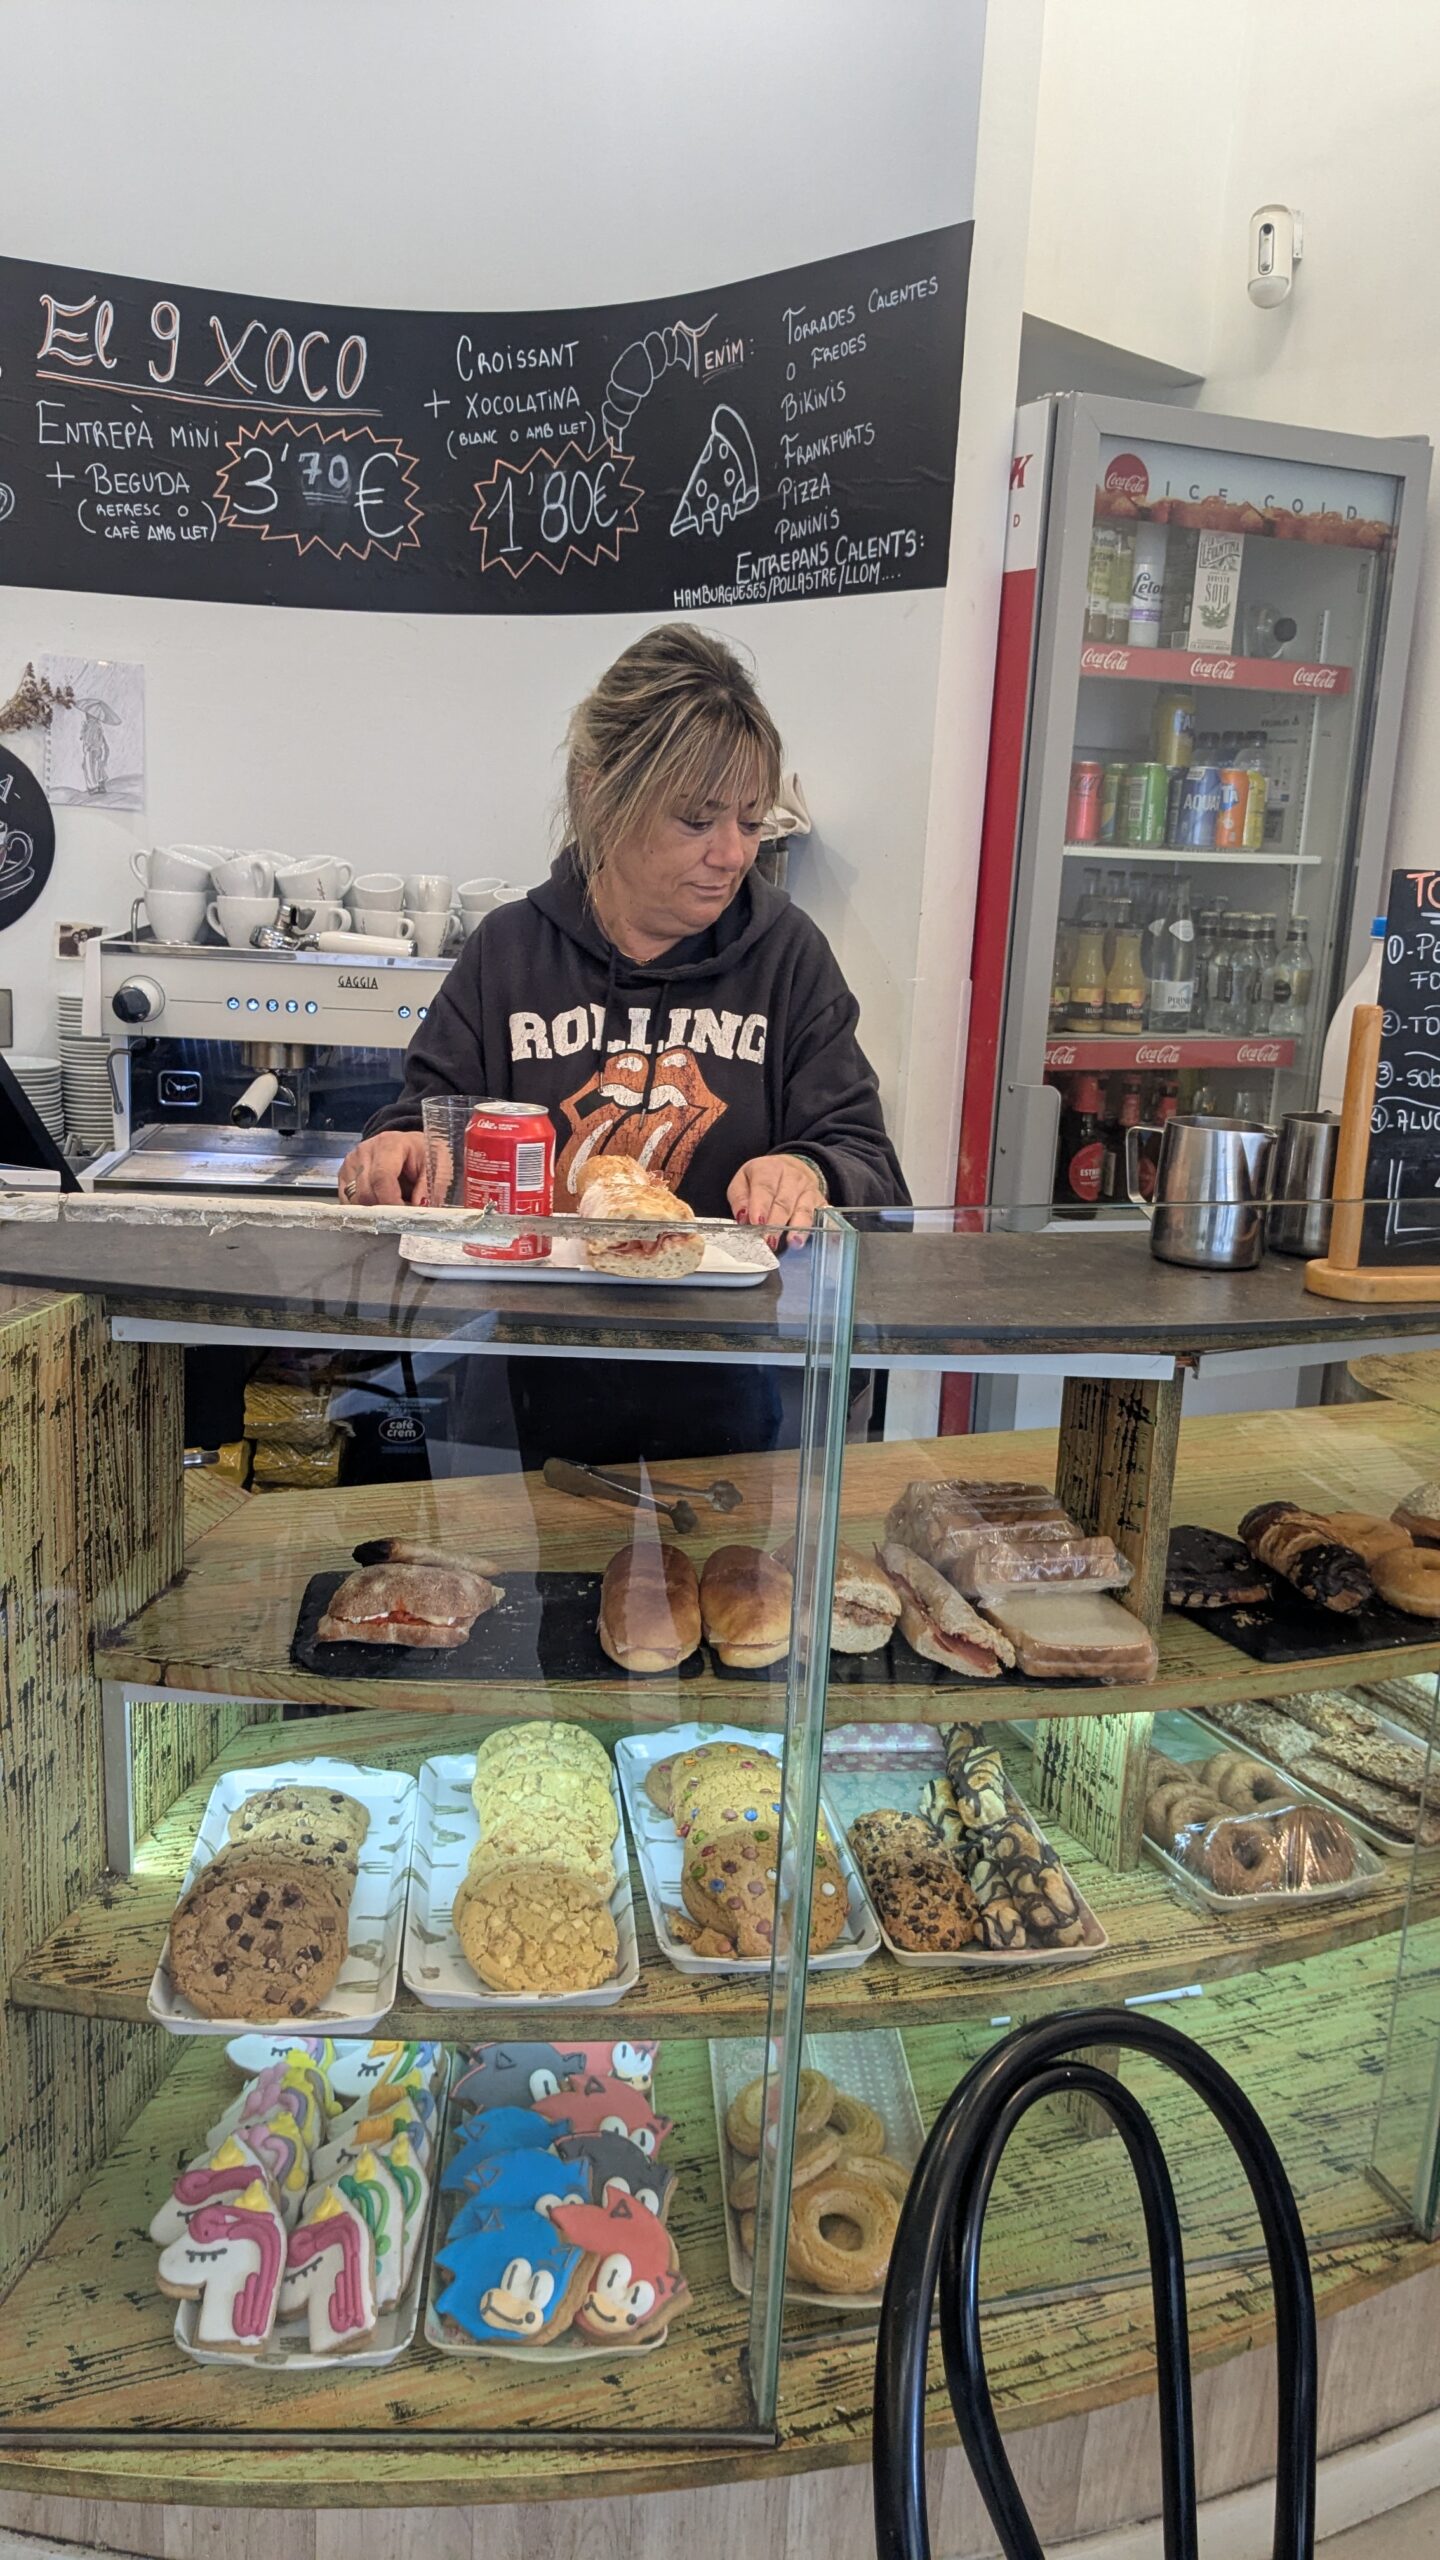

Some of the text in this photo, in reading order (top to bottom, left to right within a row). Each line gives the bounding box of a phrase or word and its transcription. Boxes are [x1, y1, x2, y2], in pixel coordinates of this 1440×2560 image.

[782, 276, 939, 345] TORRADES CALENTES
[37, 294, 117, 368] El
[526, 423, 554, 440] AMB
[780, 422, 876, 468] FRANKFURTS
[85, 463, 190, 495] BEGUDA
[147, 526, 176, 541] AMB
[736, 541, 829, 585] ENTREPANS
[1133, 572, 1165, 601] Leto
[337, 975, 379, 990] GAGGIA
[508, 1002, 769, 1065] ROLLING
[387, 1429, 416, 1438] crem
